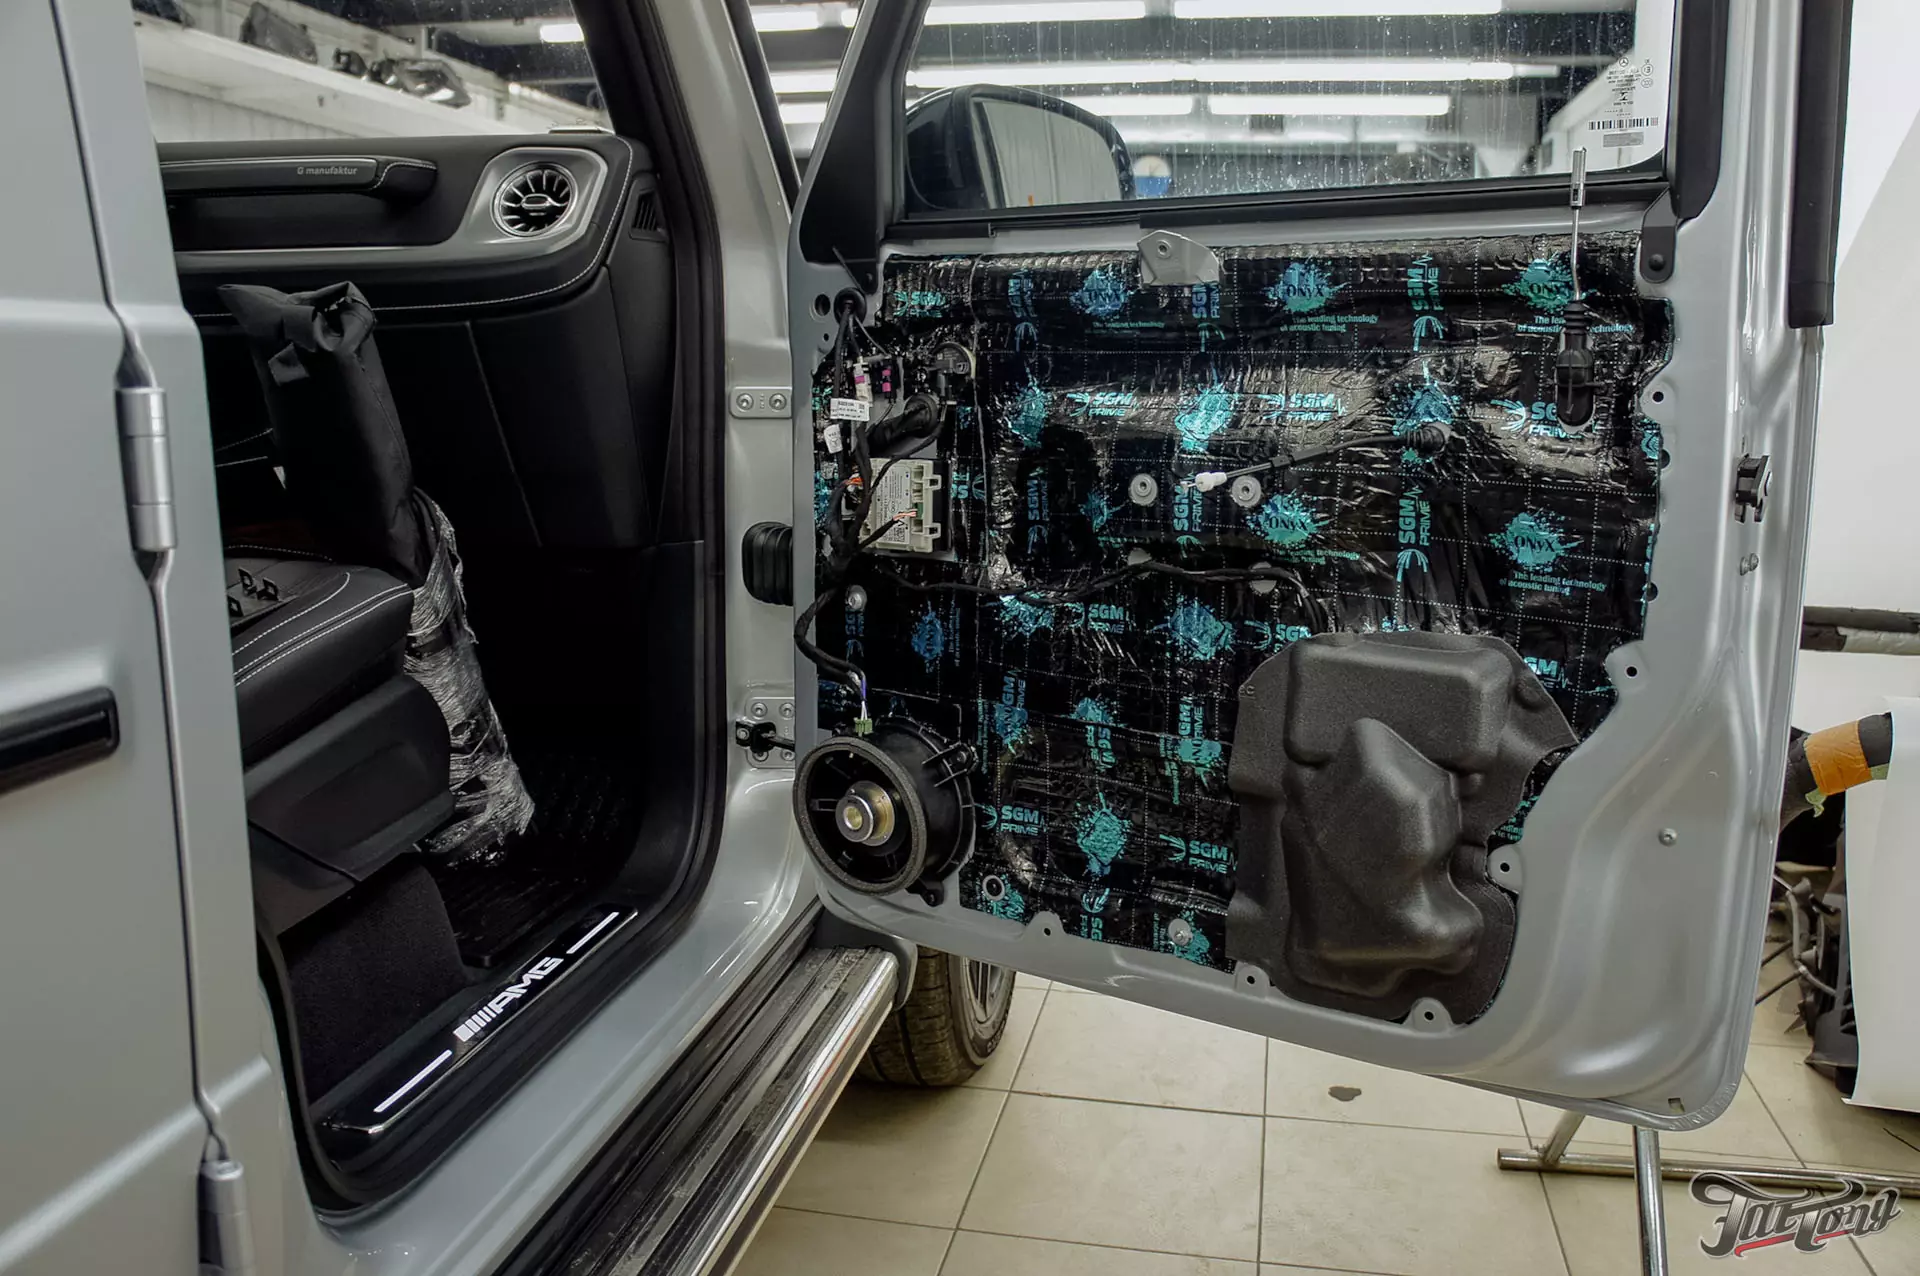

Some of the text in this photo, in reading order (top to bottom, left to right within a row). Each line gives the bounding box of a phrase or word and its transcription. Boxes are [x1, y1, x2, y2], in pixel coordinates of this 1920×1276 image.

[305, 166, 358, 175] manufaktur
[1337, 315, 1378, 324] technology
[1590, 325, 1633, 333] echnology
[1092, 392, 1133, 406] SGM
[1289, 393, 1336, 409] SGM
[1088, 408, 1126, 417] PRIME
[1531, 401, 1558, 420] SG
[1398, 499, 1416, 544] SGM
[1420, 500, 1431, 546] PRIME
[1562, 578, 1606, 592] technology
[1088, 604, 1124, 620] SGM
[1002, 676, 1015, 705] GM
[1179, 703, 1192, 736] GM
[1001, 805, 1039, 825] SGM
[1001, 822, 1039, 836] PRIME
[1189, 840, 1228, 861] SGM
[1188, 857, 1228, 874] PRIME
[488, 957, 564, 1014] AMG
